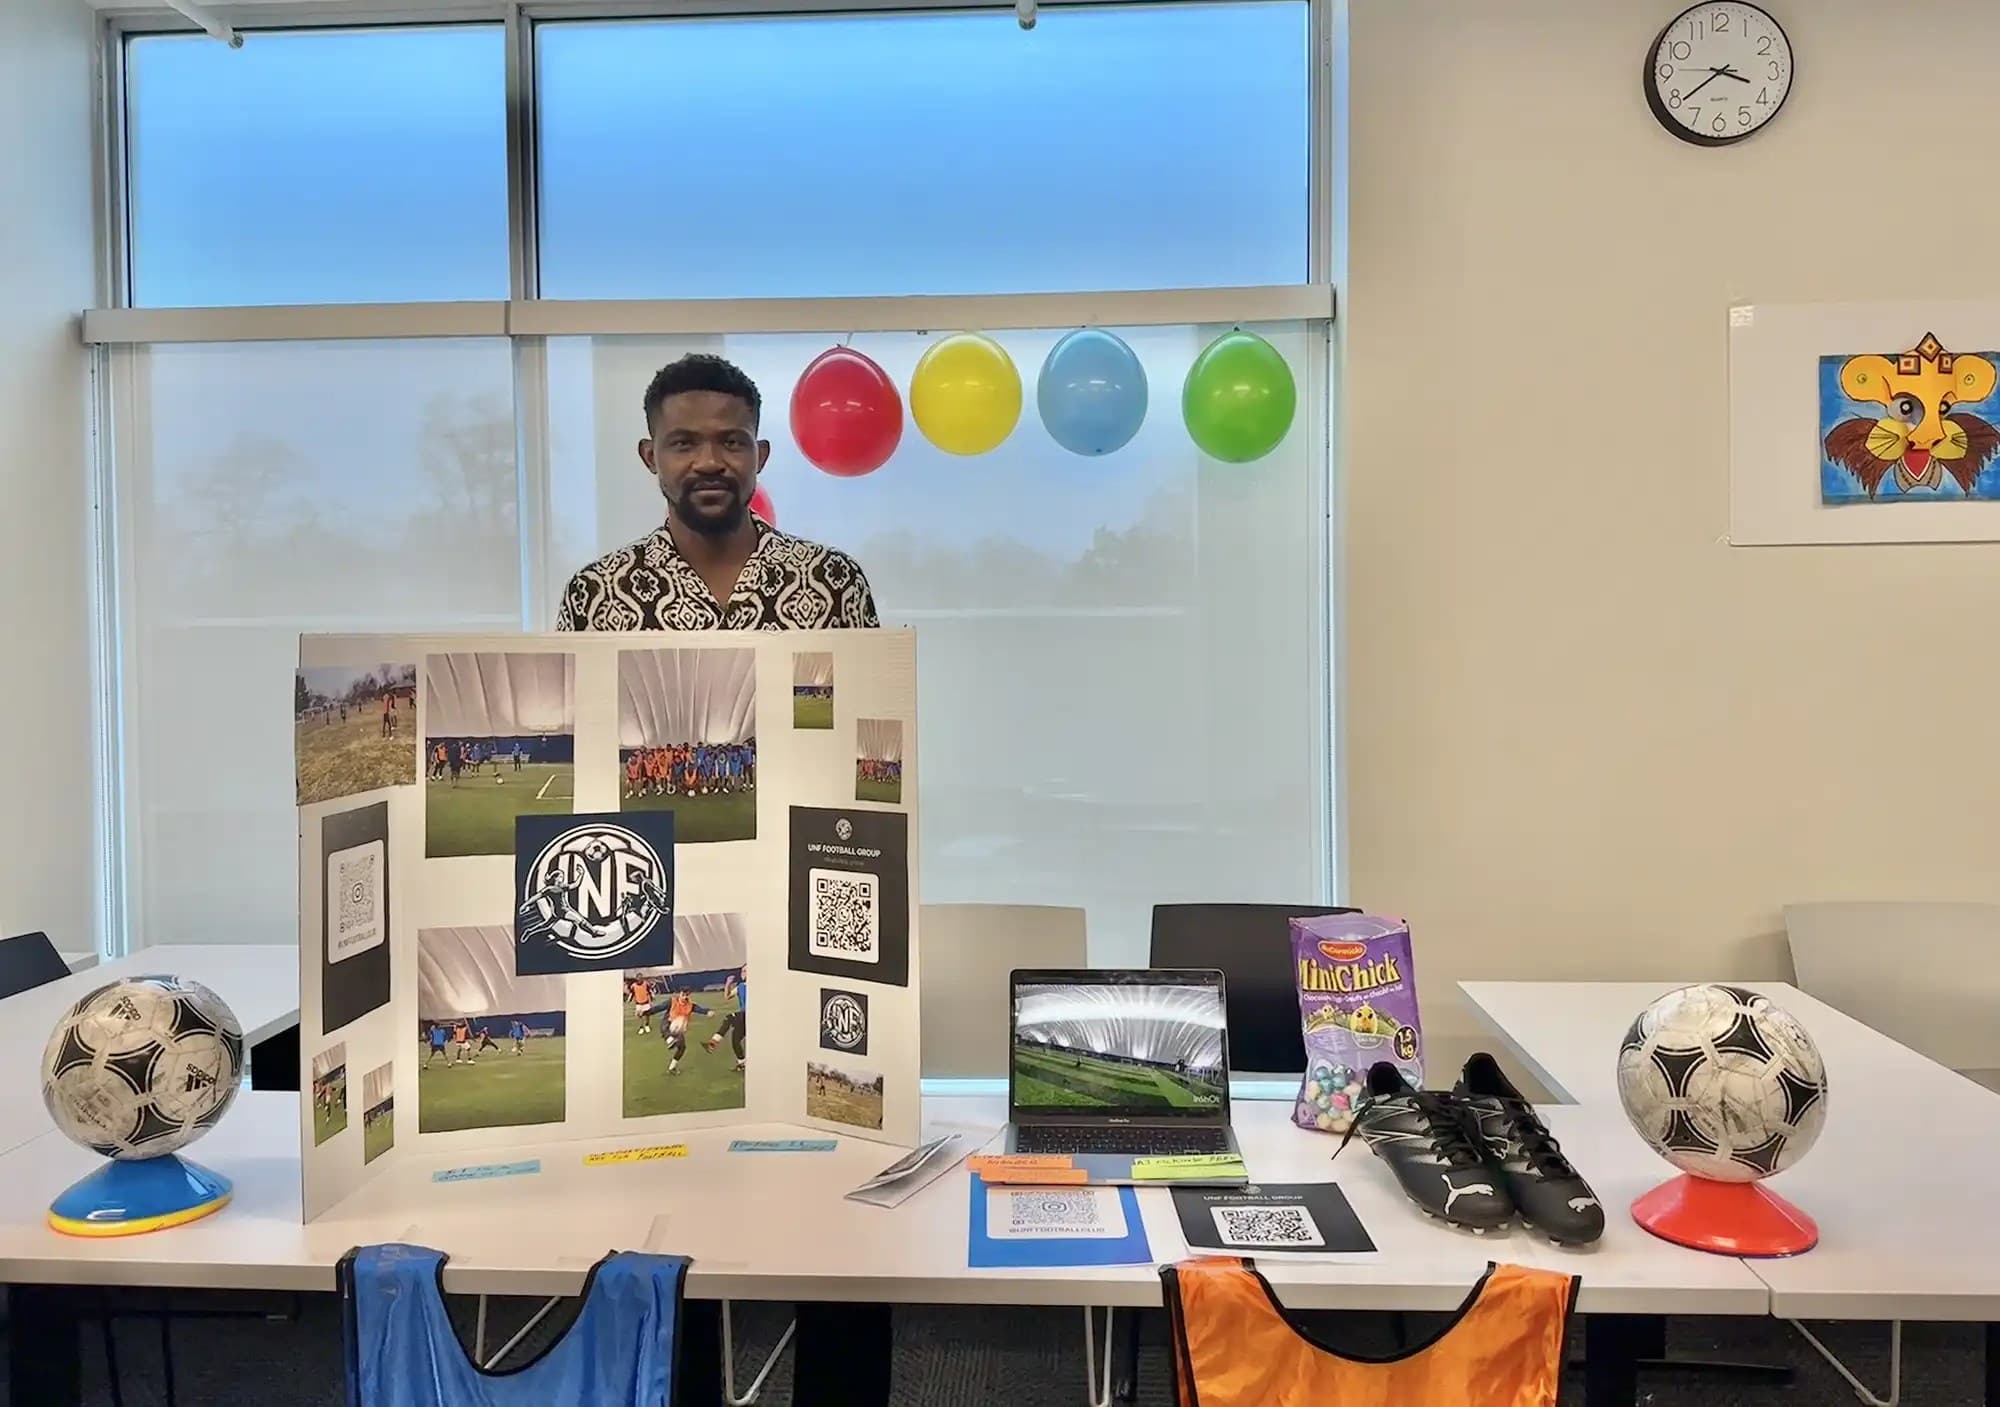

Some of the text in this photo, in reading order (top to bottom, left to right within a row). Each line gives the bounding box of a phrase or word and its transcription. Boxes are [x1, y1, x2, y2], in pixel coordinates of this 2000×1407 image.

[1689, 20, 1703, 41] 11
[1711, 12, 1729, 32] 12
[1743, 18, 1748, 38] 1
[1668, 40, 1691, 60] 10
[1756, 35, 1772, 55] 2
[1659, 63, 1674, 83] 9
[1767, 61, 1779, 81] 3
[1668, 88, 1682, 109] 8
[1755, 87, 1769, 106] 4
[1688, 107, 1701, 126] 7
[1712, 112, 1726, 132] 6
[1738, 106, 1752, 126] 5
[808, 843, 881, 857] UNF FOOTBALL GROUP
[120, 996, 142, 1021] adidas
[186, 1064, 216, 1085] adidas
